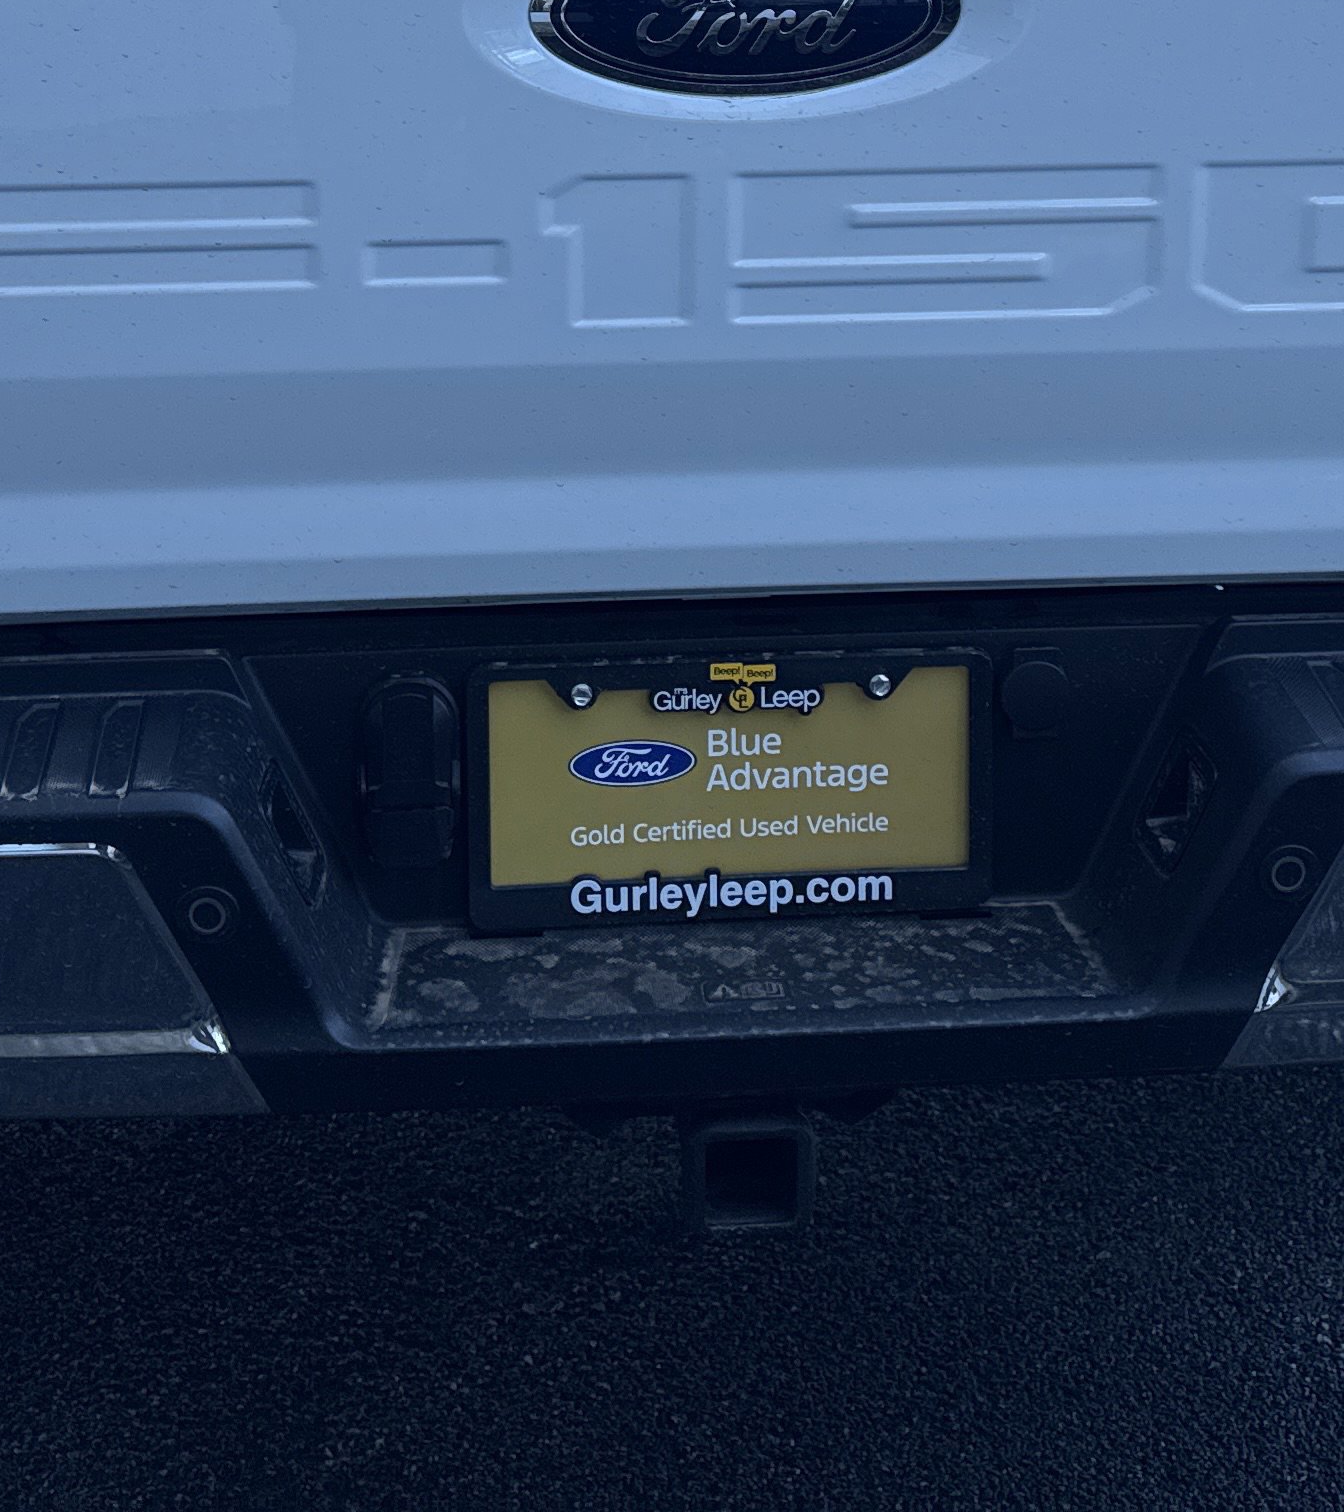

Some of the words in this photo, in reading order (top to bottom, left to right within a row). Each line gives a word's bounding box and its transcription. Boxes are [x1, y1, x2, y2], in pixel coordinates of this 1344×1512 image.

[713, 666, 741, 677] Beep!
[746, 668, 774, 679] Beep!
[653, 688, 722, 715] Gurley
[760, 687, 821, 713] Leep
[707, 728, 782, 757] Blue
[594, 747, 669, 779] Ford
[706, 761, 889, 792] Advantage
[570, 824, 625, 847] Gold
[633, 818, 731, 844] Certified
[739, 815, 799, 838] Used
[806, 812, 889, 835] Vehicle
[570, 873, 893, 918] Gurleyleep.com
